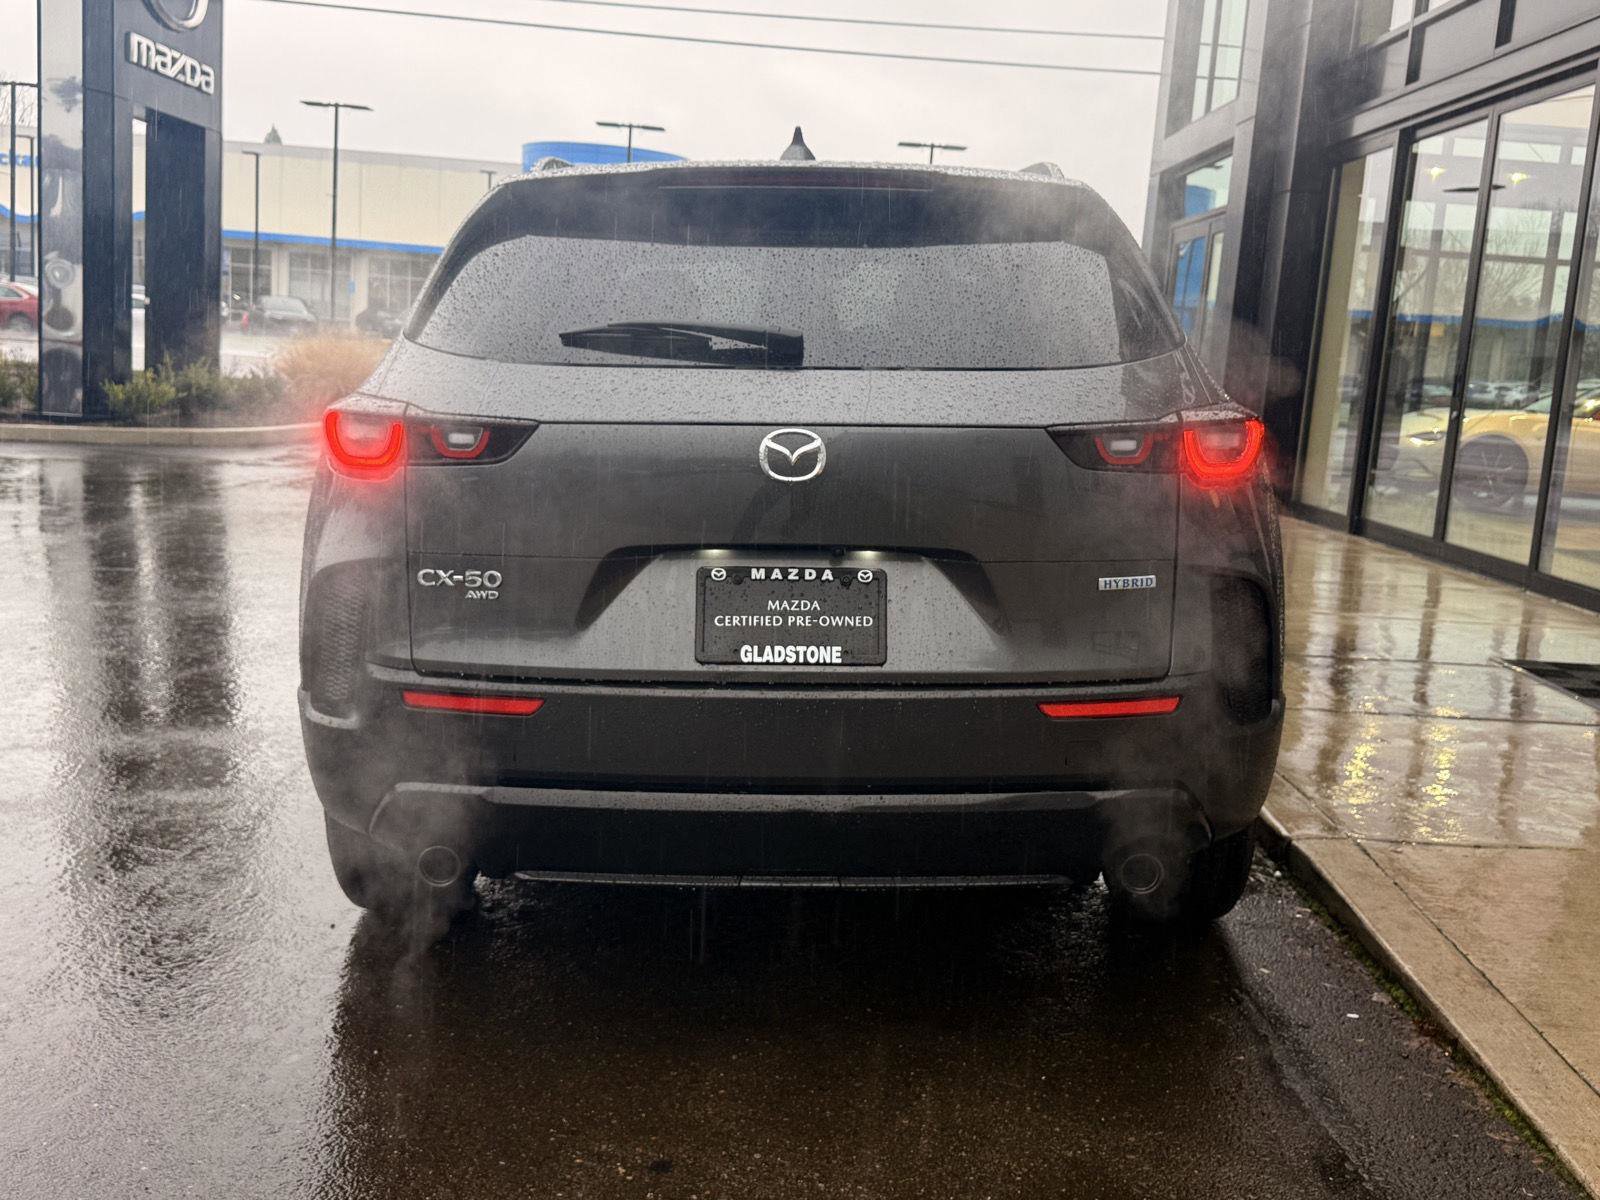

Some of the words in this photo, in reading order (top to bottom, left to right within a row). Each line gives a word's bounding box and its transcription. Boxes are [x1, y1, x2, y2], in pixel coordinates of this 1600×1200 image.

[417, 568, 502, 588] CX-50
[750, 568, 834, 581] MAZDA
[1103, 577, 1154, 589] HYBRID
[465, 590, 499, 600] AWD
[767, 600, 821, 611] MAZDA
[714, 615, 783, 627] CERTIFIED
[788, 615, 874, 627] PRE-OWNED
[740, 644, 842, 664] GLADSTONE
